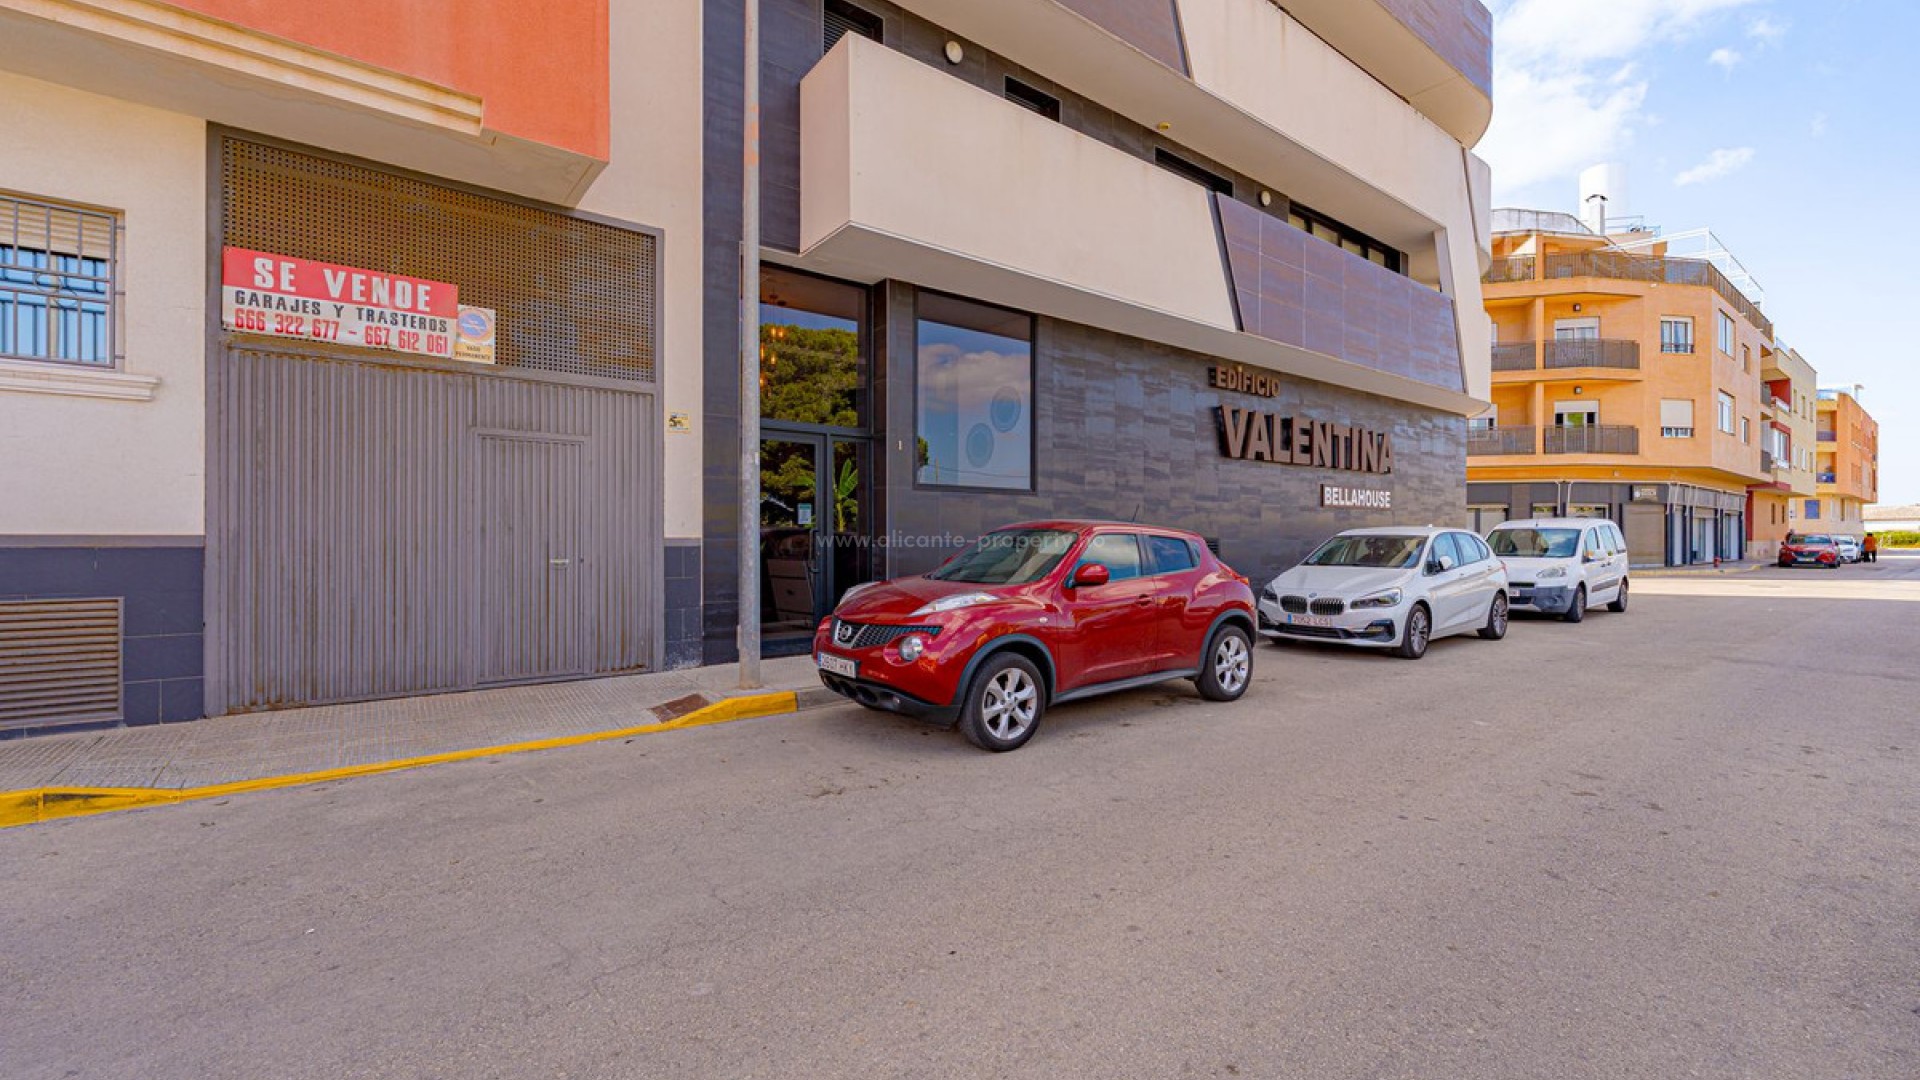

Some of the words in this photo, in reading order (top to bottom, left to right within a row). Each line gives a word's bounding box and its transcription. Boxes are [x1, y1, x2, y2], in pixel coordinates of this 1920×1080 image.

[253, 258, 297, 292] SE
[323, 268, 431, 312] VENDE
[234, 307, 266, 331] 666
[274, 313, 304, 336] 322
[312, 318, 339, 340] 677
[364, 324, 391, 346] 667
[398, 329, 419, 351] 612
[426, 333, 448, 354] 061
[235, 289, 321, 315] GARAJES
[333, 304, 344, 318] Y
[356, 307, 447, 333] TRASTEROS
[1215, 365, 1281, 398] EDIFICIO
[1219, 403, 1393, 475] VALENTINA
[1324, 486, 1391, 508] BELLAHOUSE
